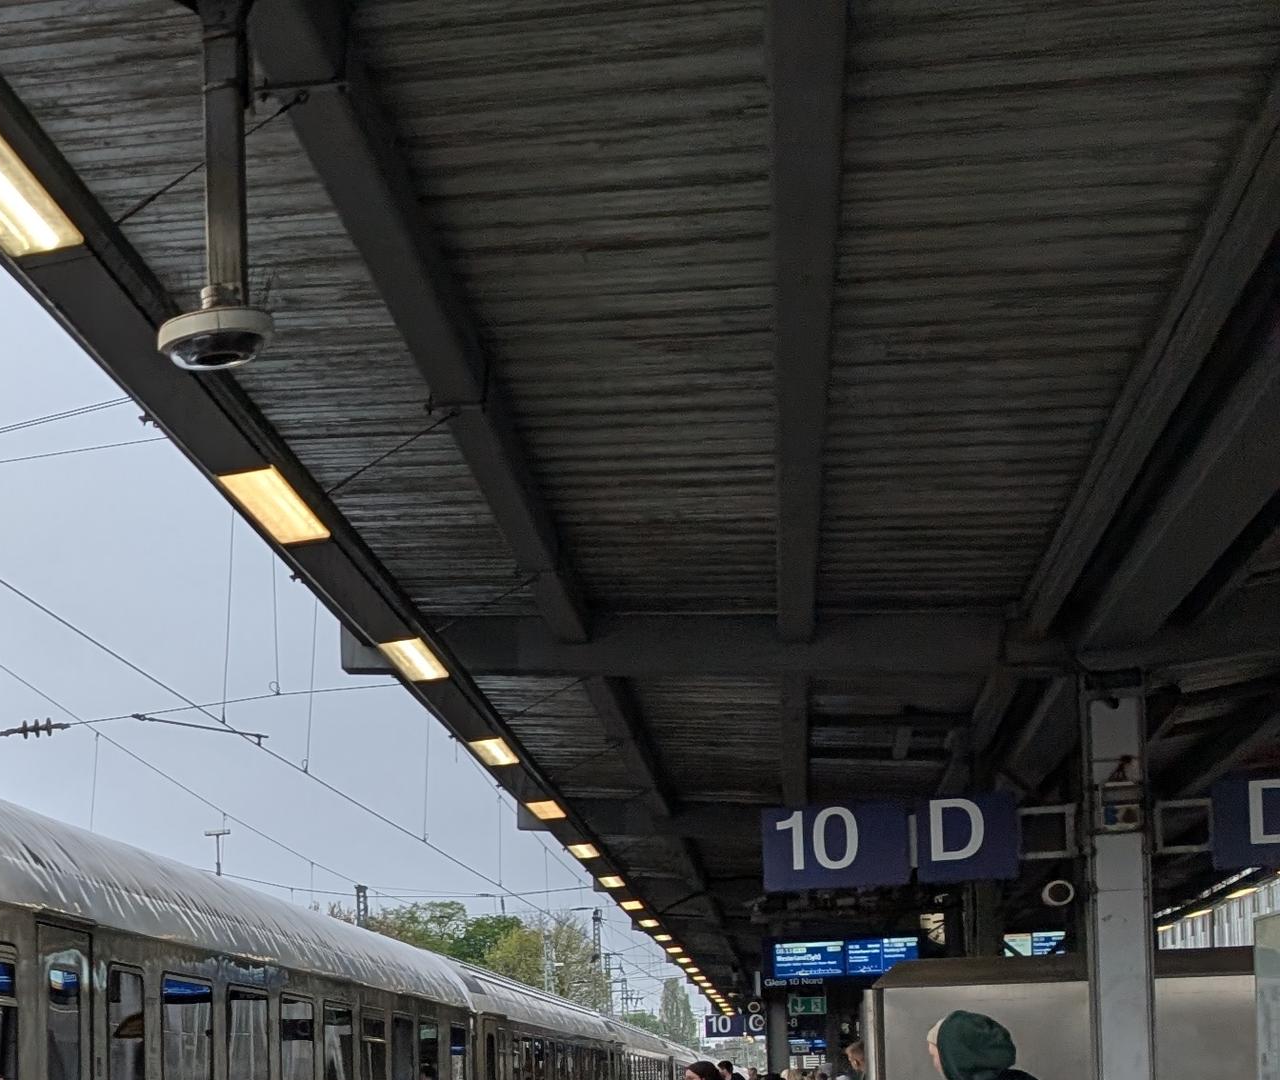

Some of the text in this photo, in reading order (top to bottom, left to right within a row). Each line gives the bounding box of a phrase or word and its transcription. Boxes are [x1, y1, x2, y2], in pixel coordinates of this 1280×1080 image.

[775, 806, 859, 871] 10
[929, 798, 985, 862] D
[789, 977, 800, 986] 10
[801, 977, 823, 985] Nord
[708, 1015, 731, 1033] 10
